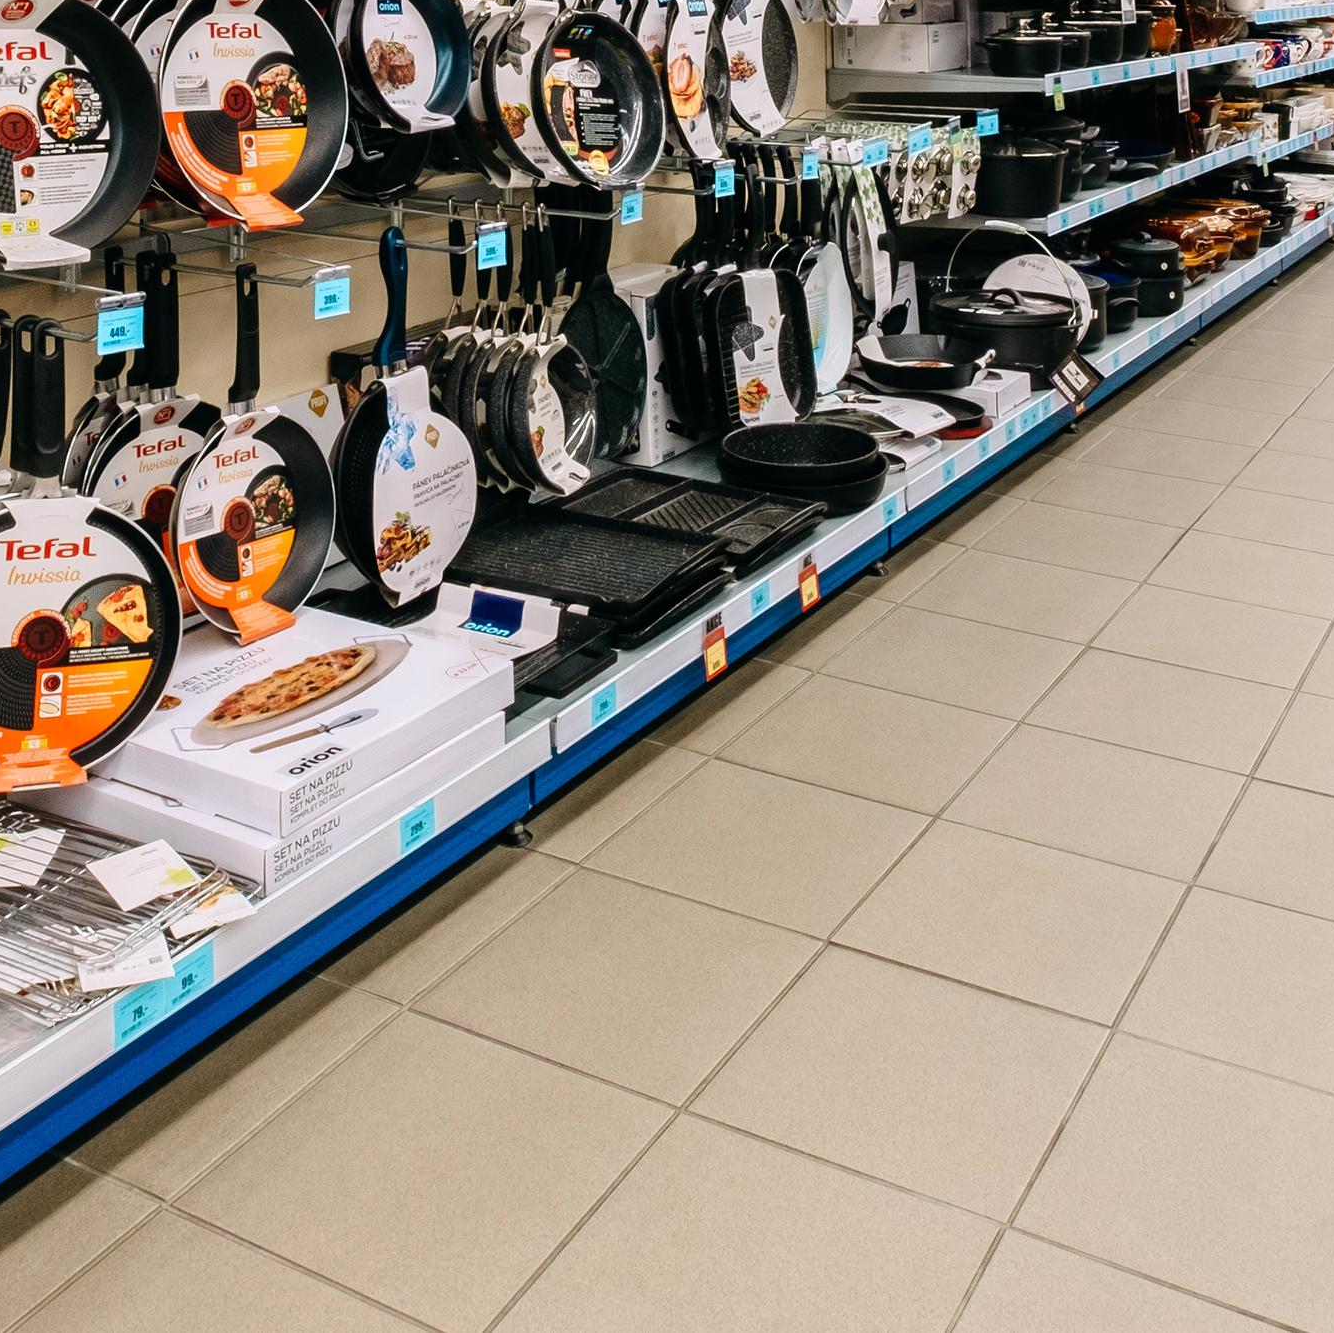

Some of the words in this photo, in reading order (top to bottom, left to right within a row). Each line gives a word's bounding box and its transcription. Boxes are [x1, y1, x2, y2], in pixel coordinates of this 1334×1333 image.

[379, 0, 400, 12] orion
[205, 22, 262, 39] Tefal
[212, 43, 256, 58] Invissia
[109, 325, 130, 338] 449,-
[133, 436, 187, 458] Tefal
[213, 446, 259, 469] Tefal
[8, 565, 81, 586] Invissia
[465, 621, 511, 637] orion
[173, 673, 202, 691] SET
[288, 745, 343, 776] orion
[289, 785, 308, 805] SET
[309, 776, 324, 790] NA
[325, 759, 354, 783] PIZZU
[290, 800, 306, 816] SET
[305, 793, 316, 805] NA
[317, 781, 340, 800] PIZZU
[290, 804, 318, 825] KOMPLET
[273, 843, 293, 864] SET
[295, 834, 310, 848] NA
[312, 815, 341, 840] PIZZU
[274, 860, 291, 875] SET
[290, 852, 302, 864] NA
[303, 837, 327, 857] PIZZU
[274, 861, 305, 884] KOMPLET
[180, 973, 199, 990] 99,-
[132, 1004, 148, 1021] 79,-
